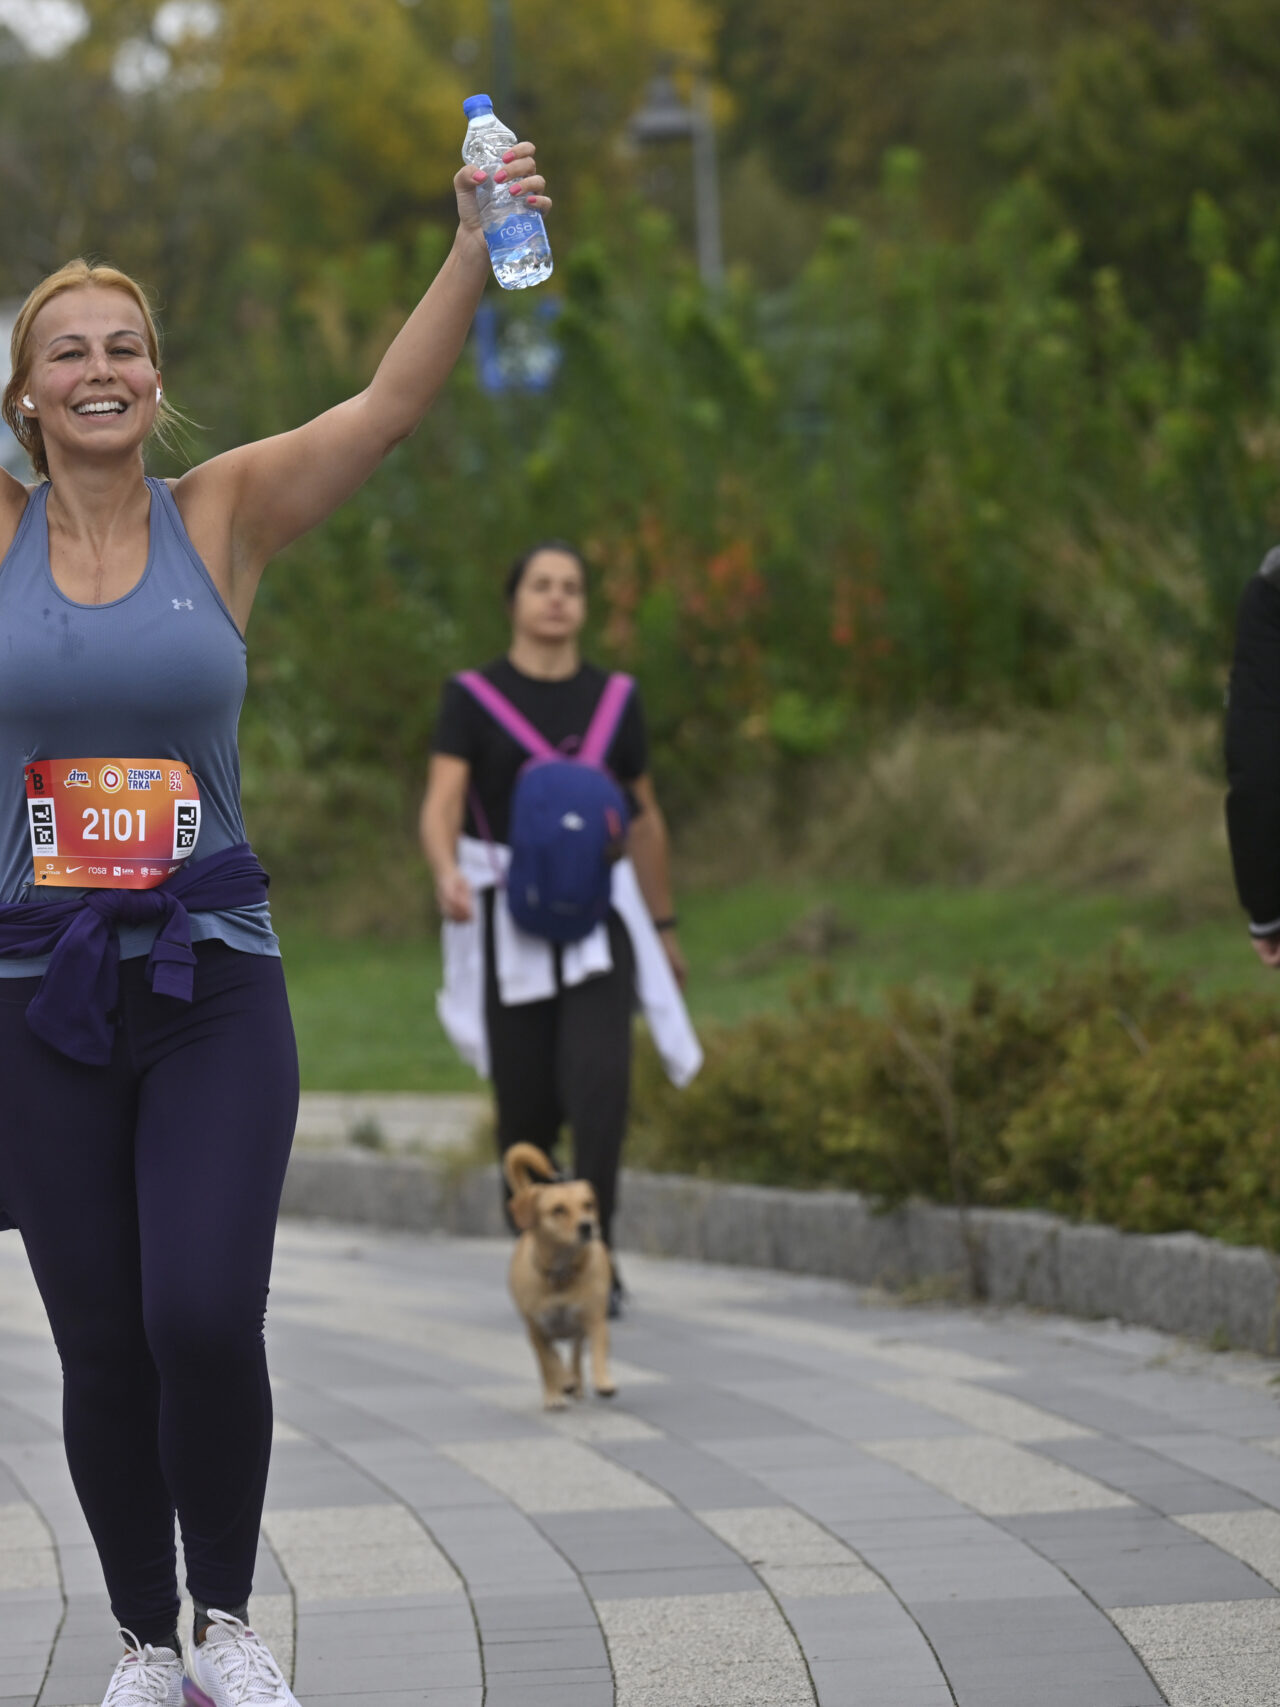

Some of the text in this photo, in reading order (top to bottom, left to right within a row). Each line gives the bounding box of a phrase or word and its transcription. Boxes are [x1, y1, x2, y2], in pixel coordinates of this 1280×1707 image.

[500, 222, 533, 239] rosa
[69, 770, 87, 781] dm
[127, 769, 161, 781] ŽENSKA
[170, 770, 181, 780] 20
[33, 773, 44, 790] B
[128, 780, 151, 790] TRKA
[170, 780, 182, 790] 24
[82, 807, 146, 841] 2101
[88, 866, 107, 875] rosa
